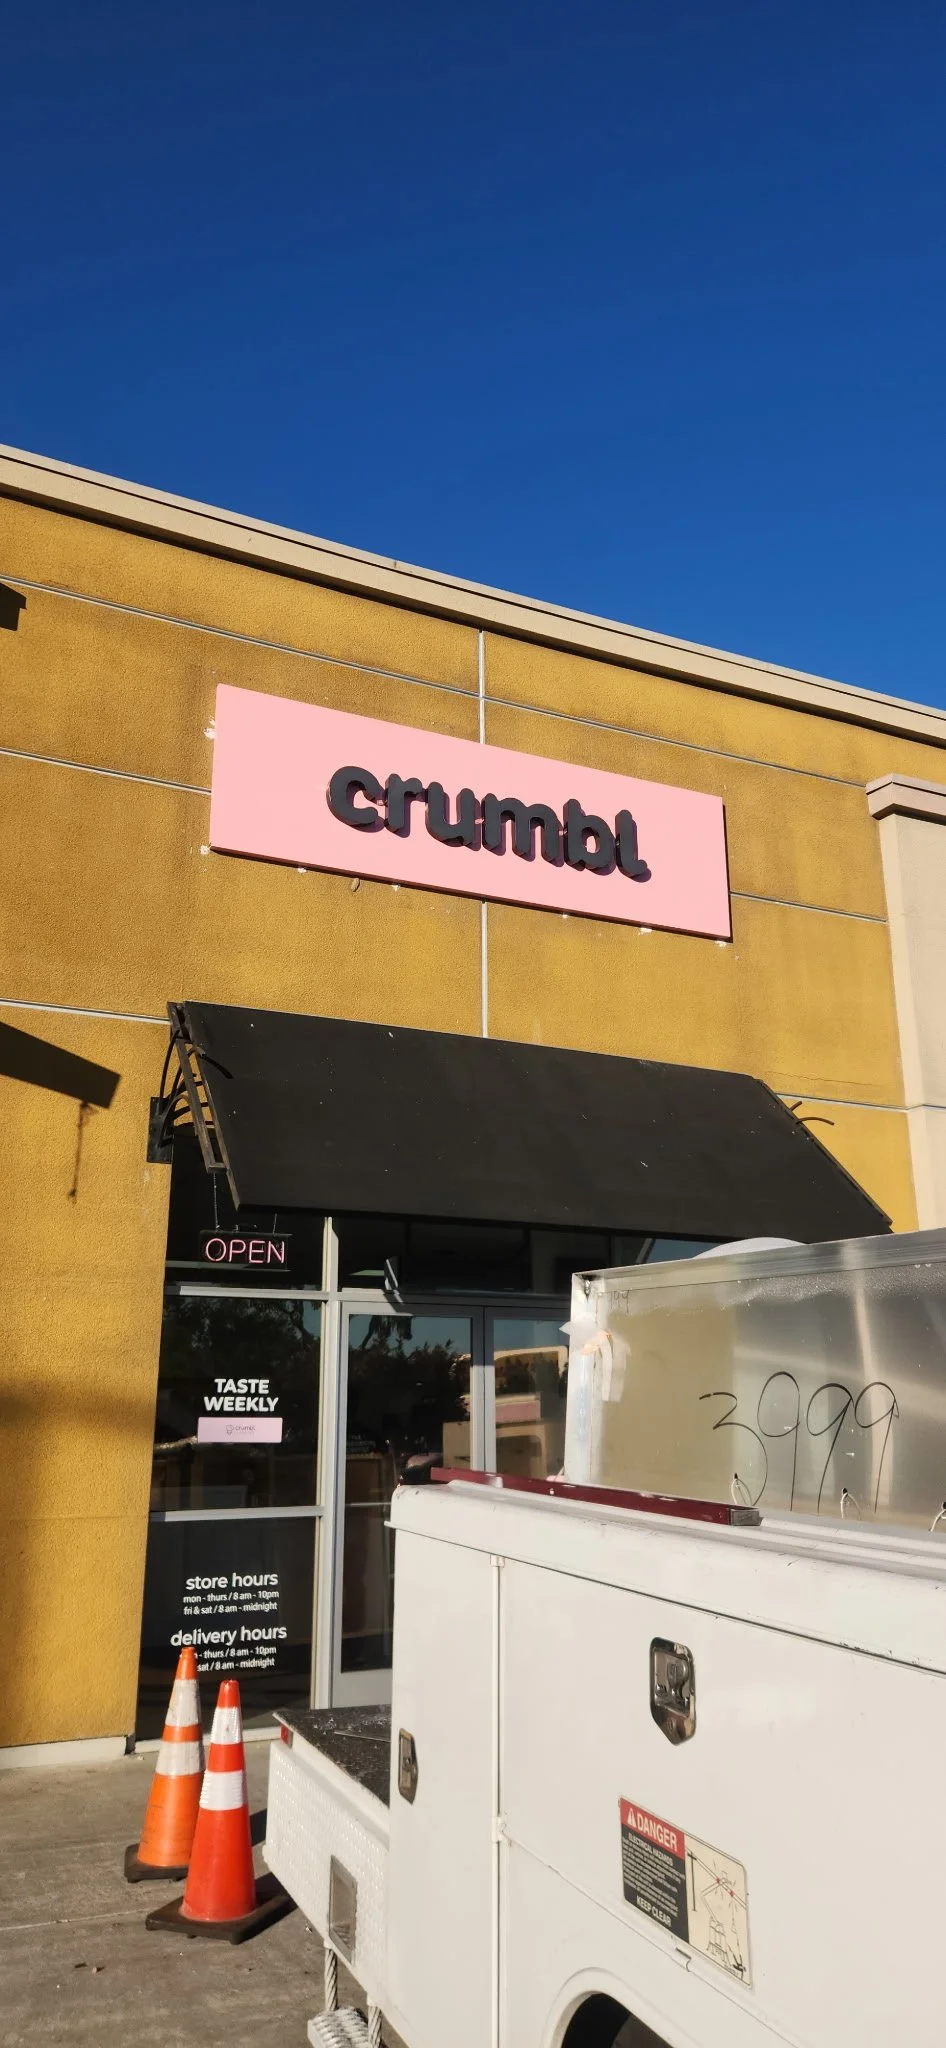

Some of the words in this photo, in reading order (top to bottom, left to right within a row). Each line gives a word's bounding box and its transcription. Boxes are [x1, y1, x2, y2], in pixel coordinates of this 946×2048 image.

[327, 765, 651, 882] crumbl
[205, 1238, 285, 1264] OPEN
[214, 1378, 269, 1394] TASTE
[203, 1396, 279, 1412] WEEKLY
[699, 1371, 899, 1514] 3999
[186, 1576, 228, 1590] store
[232, 1572, 278, 1587] hours
[207, 1592, 227, 1602] thurs
[233, 1592, 238, 1600] 8
[239, 1592, 252, 1600] am
[258, 1591, 279, 1600] 10pm
[184, 1606, 192, 1615] fri
[193, 1606, 200, 1615] &
[201, 1606, 212, 1614] sat
[218, 1604, 224, 1613] 8
[243, 1602, 277, 1612] midnight
[170, 1628, 237, 1646] delivery
[240, 1626, 287, 1641] hours
[204, 1649, 224, 1659] thurs
[230, 1648, 236, 1657] 8
[255, 1646, 276, 1656] 10pm
[197, 1663, 209, 1672] sat
[215, 1661, 221, 1670] 8
[240, 1658, 275, 1668] midnight
[637, 1810, 678, 1852] DANGER
[636, 1895, 652, 1912] KEEP
[652, 1905, 672, 1927] CLEAR
